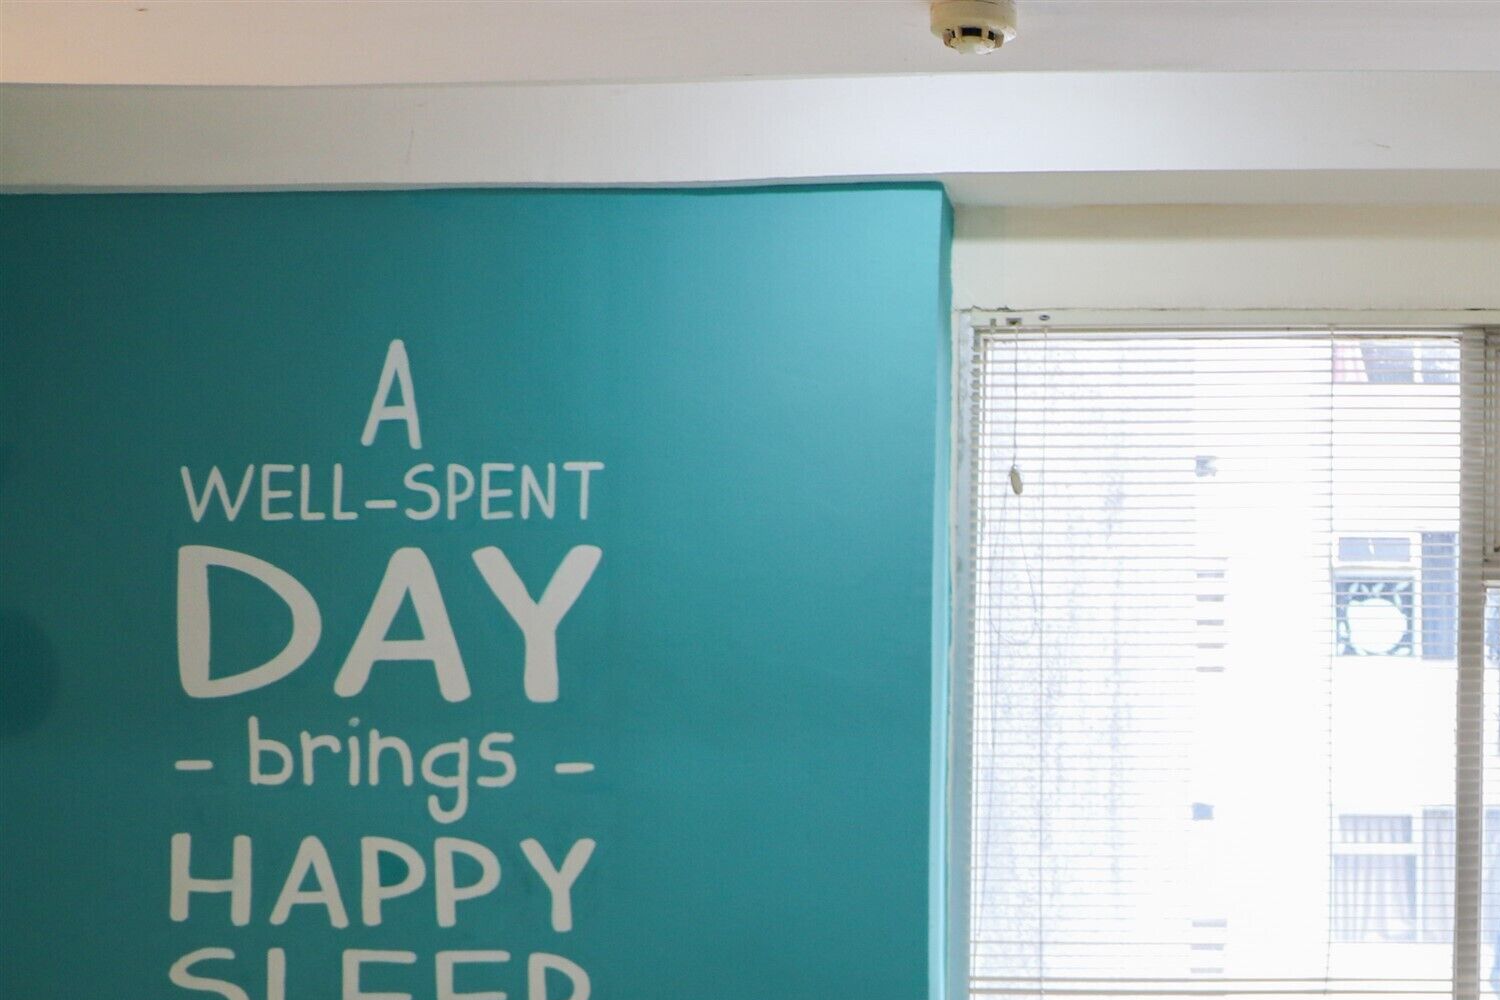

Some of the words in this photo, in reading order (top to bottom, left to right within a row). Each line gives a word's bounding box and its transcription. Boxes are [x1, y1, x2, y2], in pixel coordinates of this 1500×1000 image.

[361, 339, 422, 449] A
[181, 461, 605, 523] WELL-SPENT
[177, 544, 603, 703] DAY
[248, 715, 517, 824] brings
[169, 832, 596, 932] HAPPY
